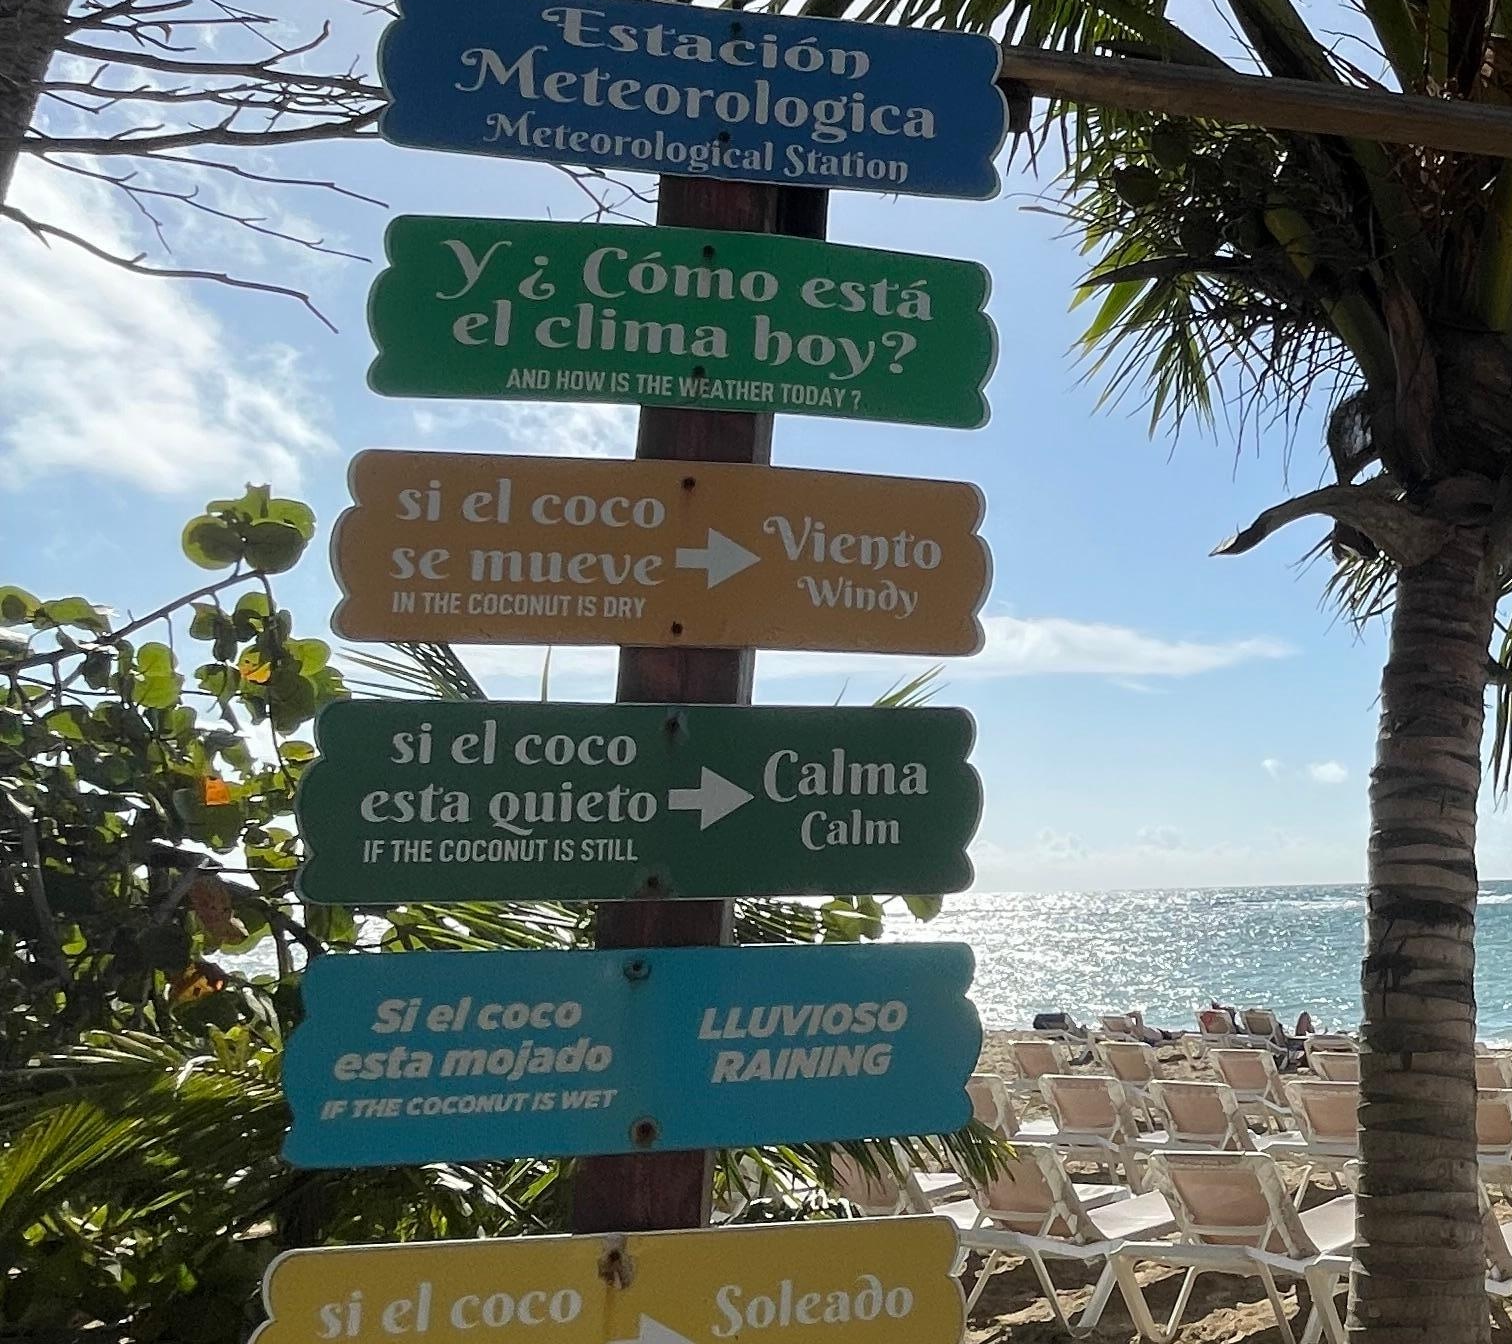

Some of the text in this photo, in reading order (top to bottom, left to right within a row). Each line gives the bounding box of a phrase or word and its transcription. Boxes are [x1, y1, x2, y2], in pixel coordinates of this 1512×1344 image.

[541, 6, 869, 80] Estación
[454, 46, 936, 143] Meteorologica
[483, 112, 908, 183] Meteorological Station
[436, 239, 512, 300] Y
[583, 247, 778, 302] Cómo
[802, 276, 933, 321] está
[452, 300, 512, 347] el
[536, 303, 729, 360] clima
[507, 367, 551, 390] AND
[556, 368, 606, 393] HOW
[610, 372, 630, 394] IS
[635, 373, 673, 396] THE
[678, 375, 775, 401] WEATHER
[396, 479, 666, 529] si el coco
[763, 515, 942, 571] Viento
[390, 546, 664, 587] se mueve
[392, 591, 646, 619] IN THE COCONUT IS DRY
[797, 576, 919, 619] Windy
[392, 720, 637, 766] si el coco
[762, 749, 928, 803] Calma
[360, 783, 659, 835] esta quieto
[800, 810, 900, 851] Calm
[363, 839, 639, 863] IF THE COCONUT IS STILL
[371, 997, 583, 1034] Si el coco
[698, 1001, 909, 1040] LLUVIOSO
[333, 1037, 612, 1082] esta mojado
[711, 1043, 892, 1084] RAINING
[321, 1090, 617, 1121] IF THE COCONUT IS WET
[318, 1281, 583, 1339] si el coco
[711, 1274, 915, 1338] Soleado
